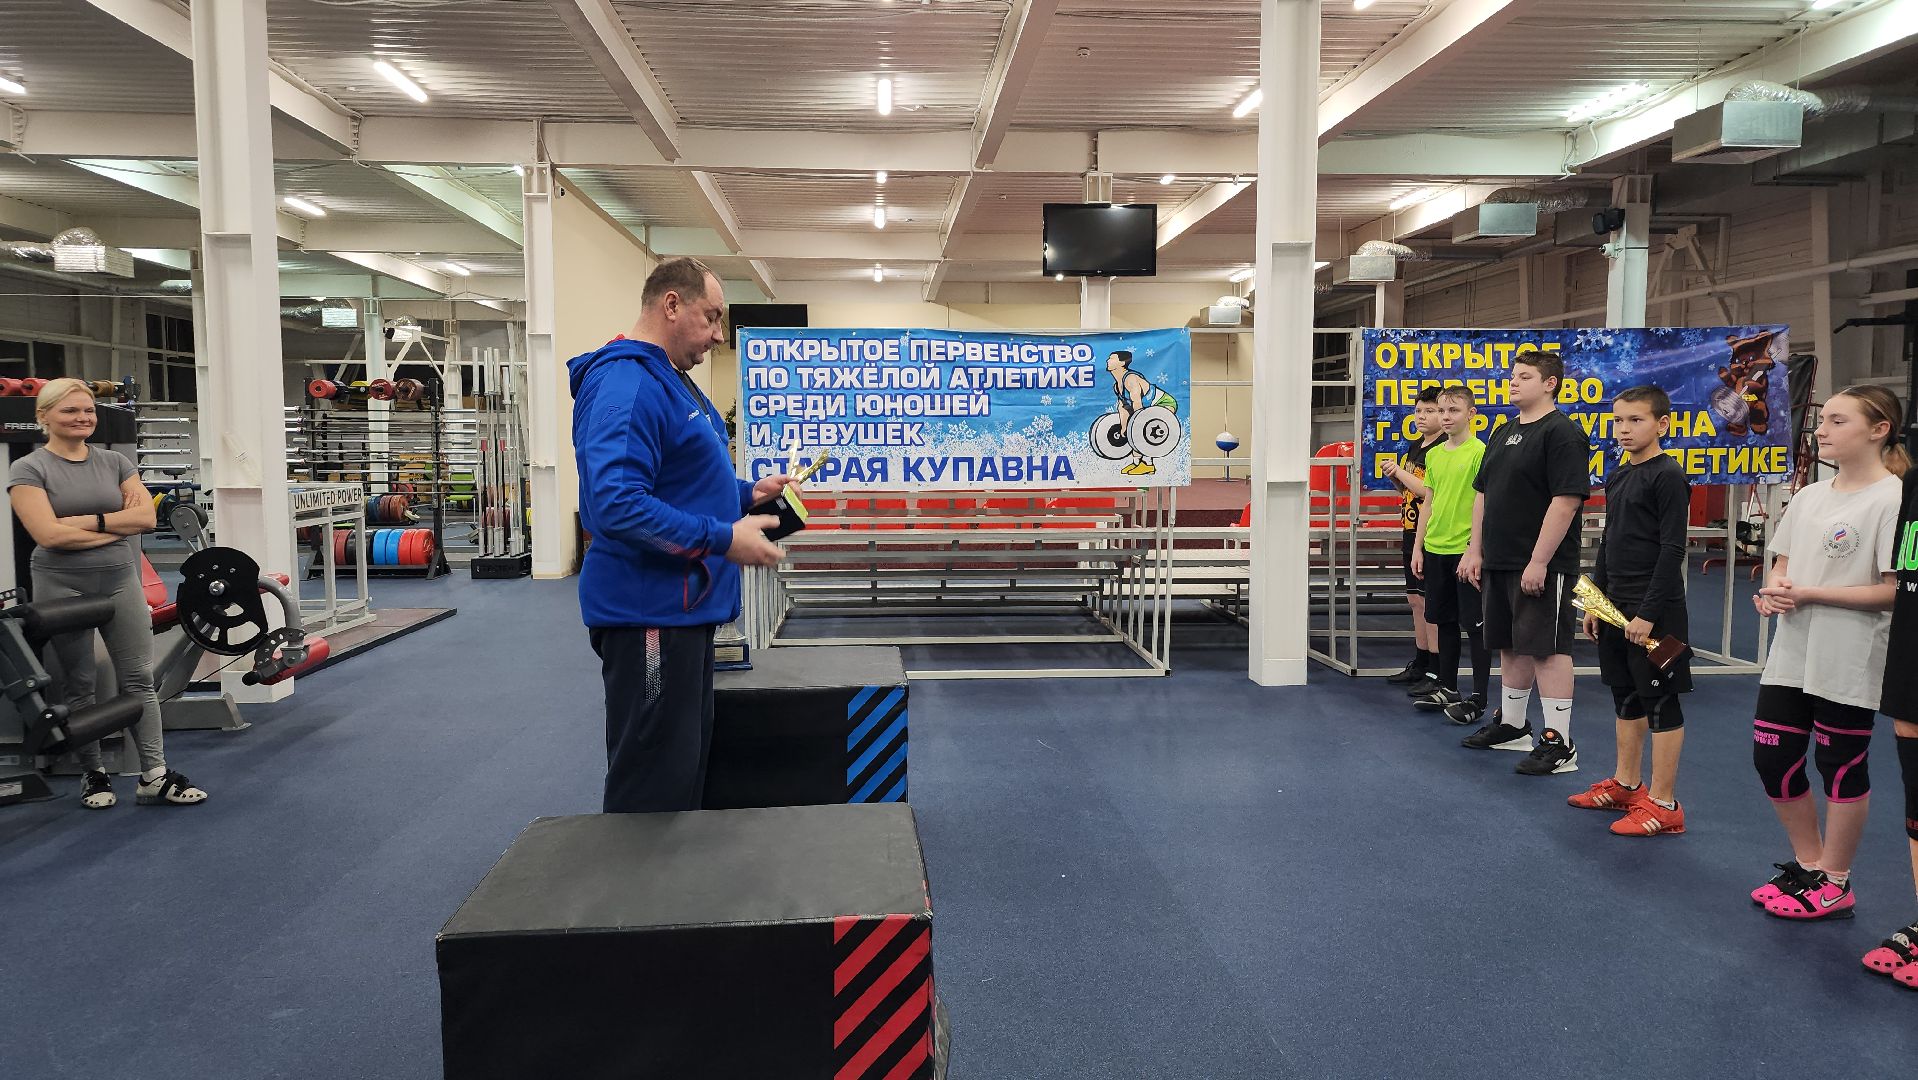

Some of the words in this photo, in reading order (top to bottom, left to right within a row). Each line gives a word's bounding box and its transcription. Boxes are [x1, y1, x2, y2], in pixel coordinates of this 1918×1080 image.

[747, 339, 900, 361] ОТКРЫТОЕ
[910, 339, 1093, 363] ПЕРВЕНСТВО
[1375, 342, 1561, 369] ОТКРЫТ
[749, 367, 788, 389] ПО
[797, 362, 940, 389] ТЯЖЁЛОЙ
[950, 366, 1094, 388] АТЛЕТИКЕ
[750, 395, 845, 419] СРЕДИ
[856, 390, 990, 416] ЮНОШЕЙ
[1375, 377, 1604, 406] ПЕЕНВО
[750, 424, 771, 446] И
[782, 423, 924, 449] ДЕВУШЕК
[902, 455, 1075, 482] КУПАВНА
[294, 491, 336, 509] UNLIMITED
[337, 488, 363, 504] POWER
